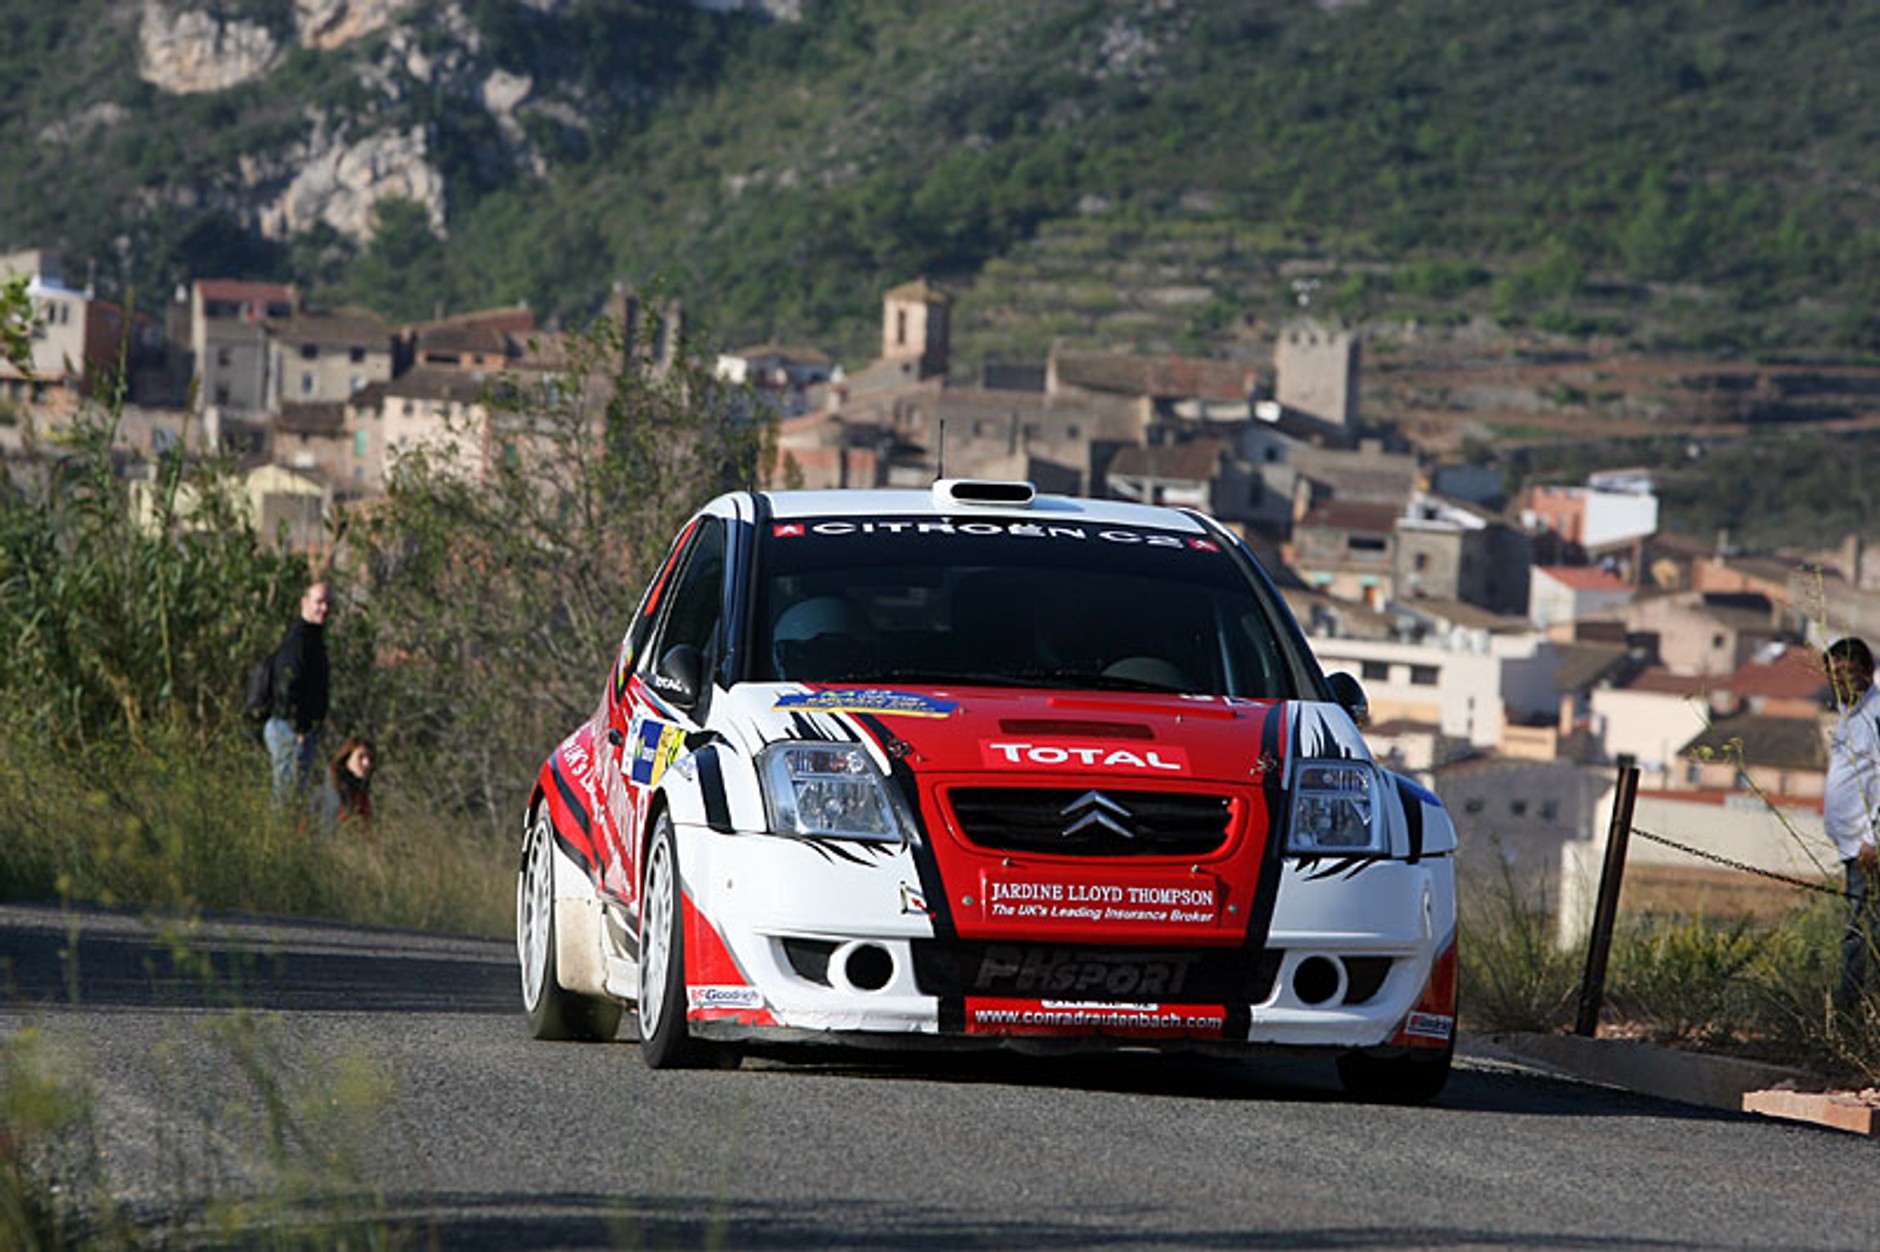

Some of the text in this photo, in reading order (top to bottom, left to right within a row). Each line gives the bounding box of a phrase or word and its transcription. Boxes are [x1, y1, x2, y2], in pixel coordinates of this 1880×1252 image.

[1100, 530, 1184, 548] C2
[989, 743, 1181, 770] TOTAL
[991, 883, 1214, 905] JARDINE LLOYD THOMPSON
[992, 904, 1214, 922] The UK's Leading Insurance Broker
[975, 1009, 1223, 1029] www.conradrautenbach.com
